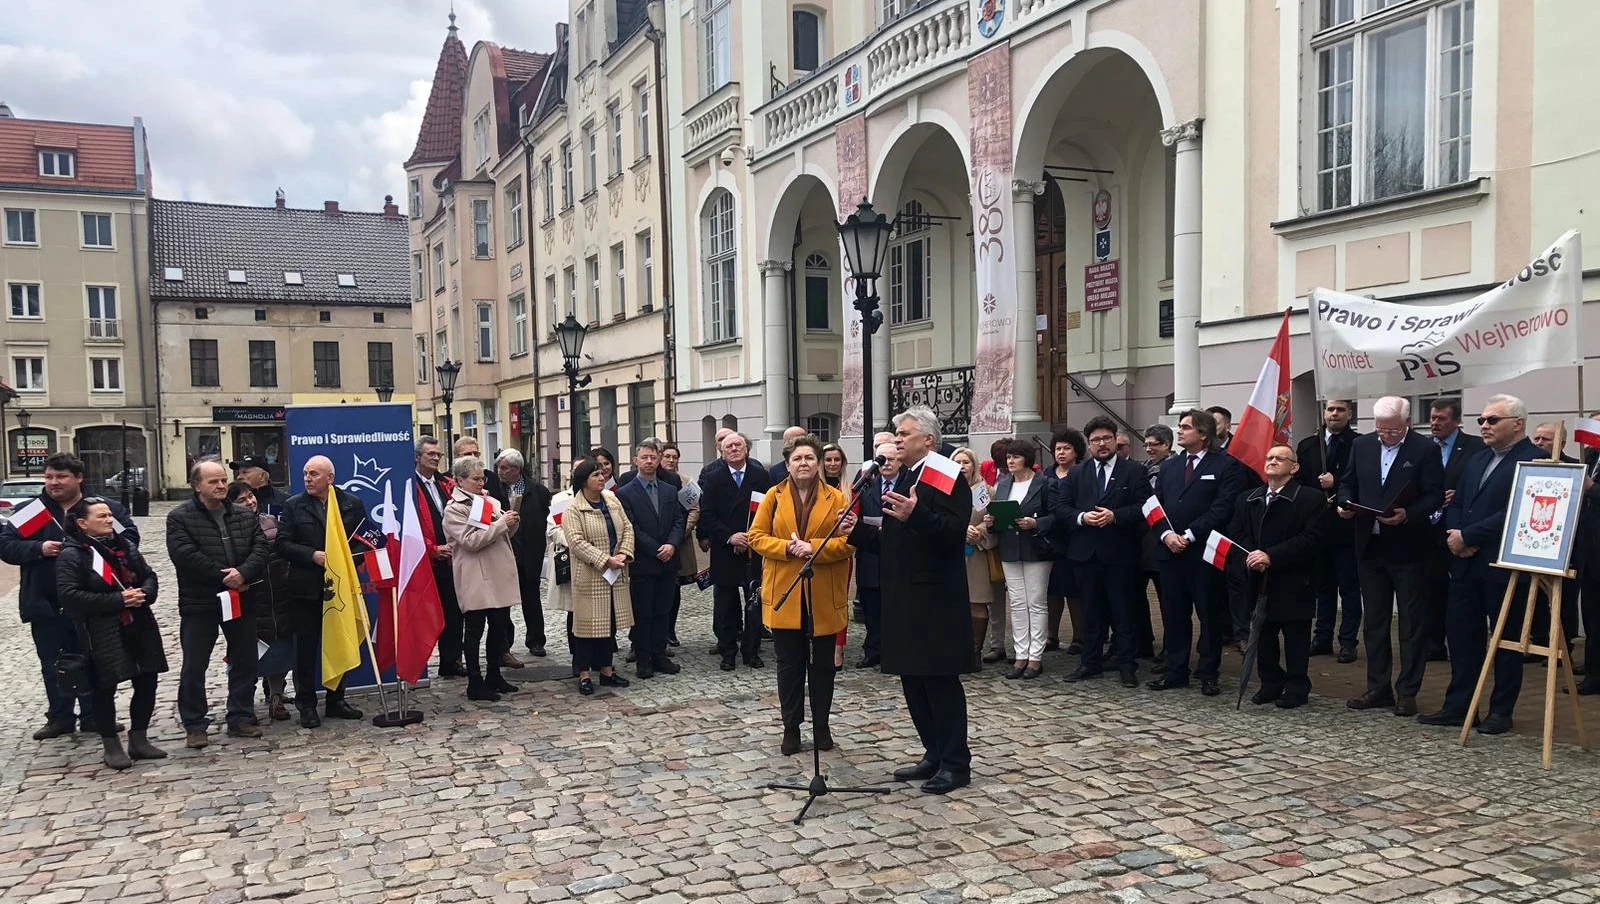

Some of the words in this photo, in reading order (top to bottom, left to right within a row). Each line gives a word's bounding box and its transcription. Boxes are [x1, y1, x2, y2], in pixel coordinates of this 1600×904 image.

[1318, 300, 1383, 331] Prawo
[1387, 315, 1399, 331] i
[1321, 349, 1373, 369] Komitet
[1396, 351, 1462, 381] PiS
[1455, 308, 1569, 353] Wejherowo
[291, 434, 324, 446] Prawo
[330, 431, 411, 445] Sprawiedliwość
